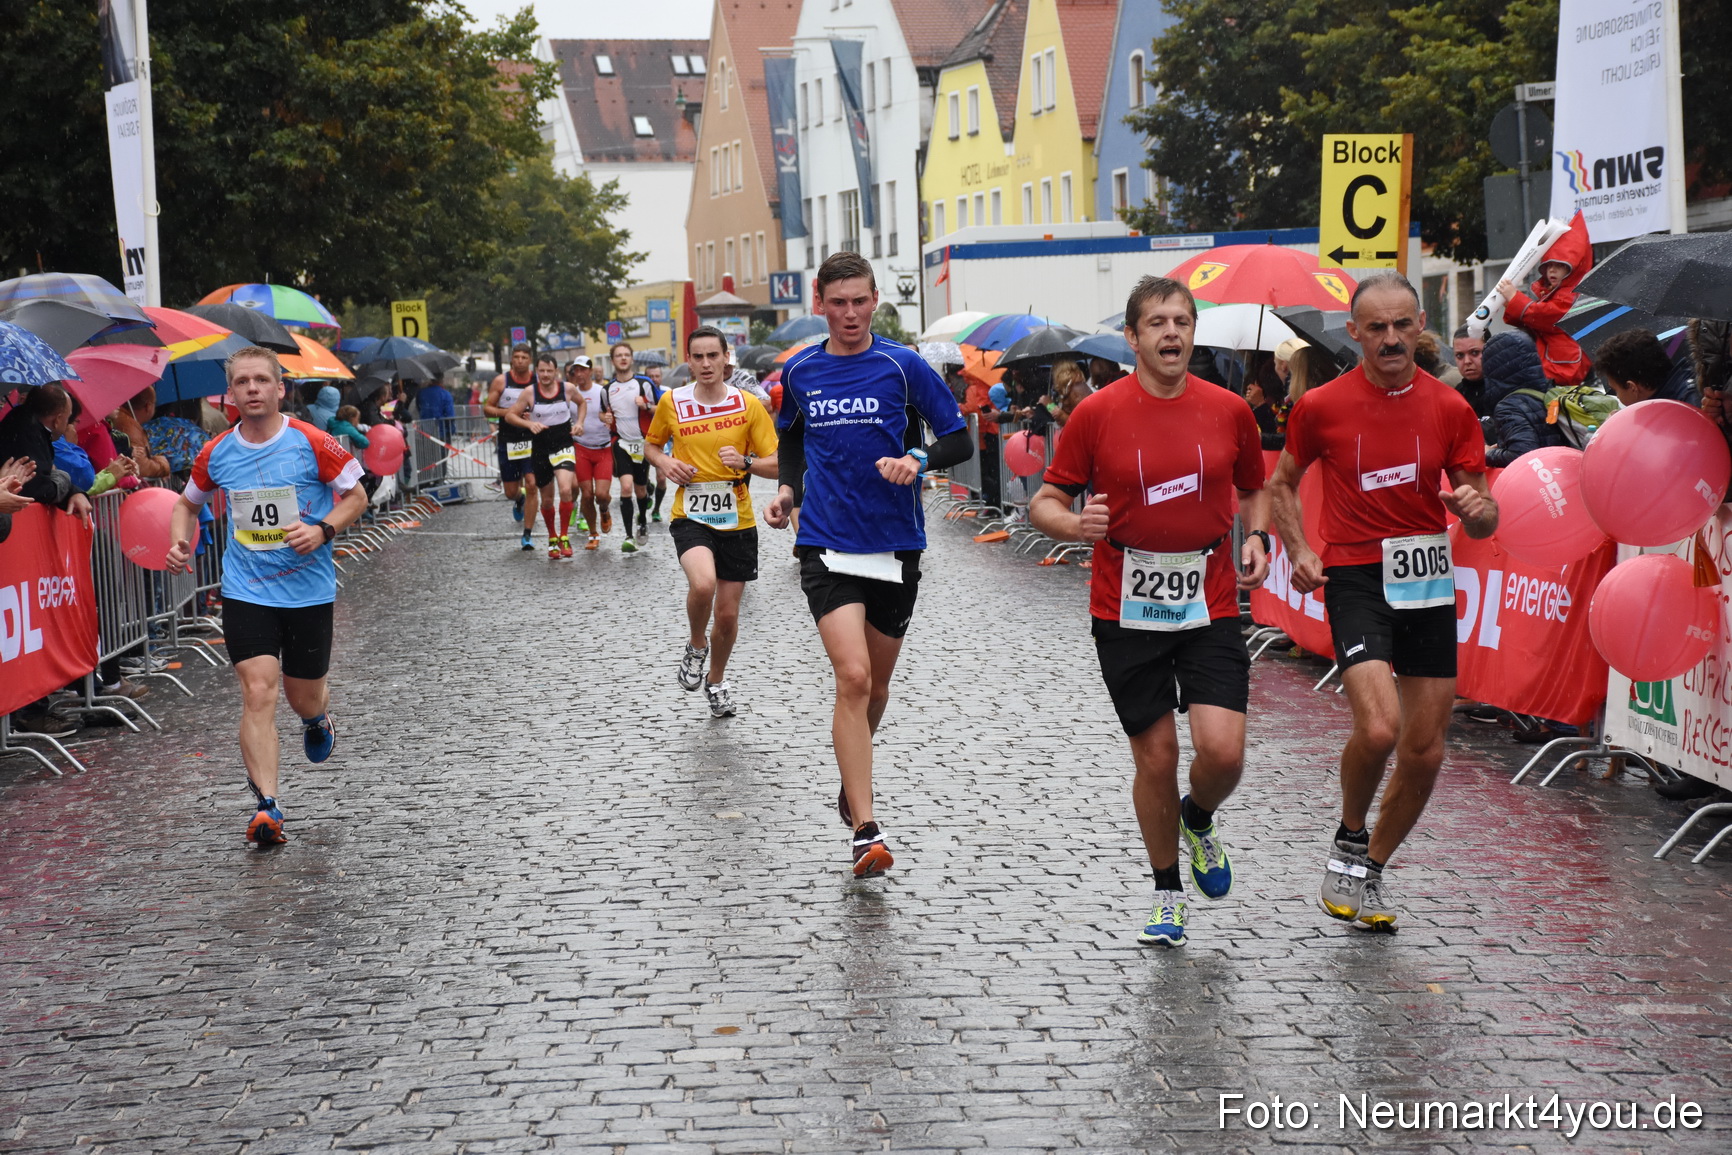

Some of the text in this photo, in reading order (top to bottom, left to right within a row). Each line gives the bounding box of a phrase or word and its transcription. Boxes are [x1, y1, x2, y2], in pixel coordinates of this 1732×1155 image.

[1333, 140, 1402, 164] Block
[1342, 174, 1388, 240] C
[396, 303, 422, 313] Block
[402, 316, 420, 338] D
[809, 397, 880, 418] SYSCAD
[679, 416, 748, 437] MAX BÖGL
[809, 417, 884, 429] www.metallbau-cad.de
[1376, 472, 1402, 484] DEHN
[1161, 482, 1185, 497] DEHN
[689, 493, 733, 513] 2794
[251, 503, 280, 527] 49
[252, 532, 284, 542] Markus
[1393, 546, 1449, 579] 3005
[1131, 569, 1200, 601] 2299
[1142, 606, 1187, 622] Manfred
